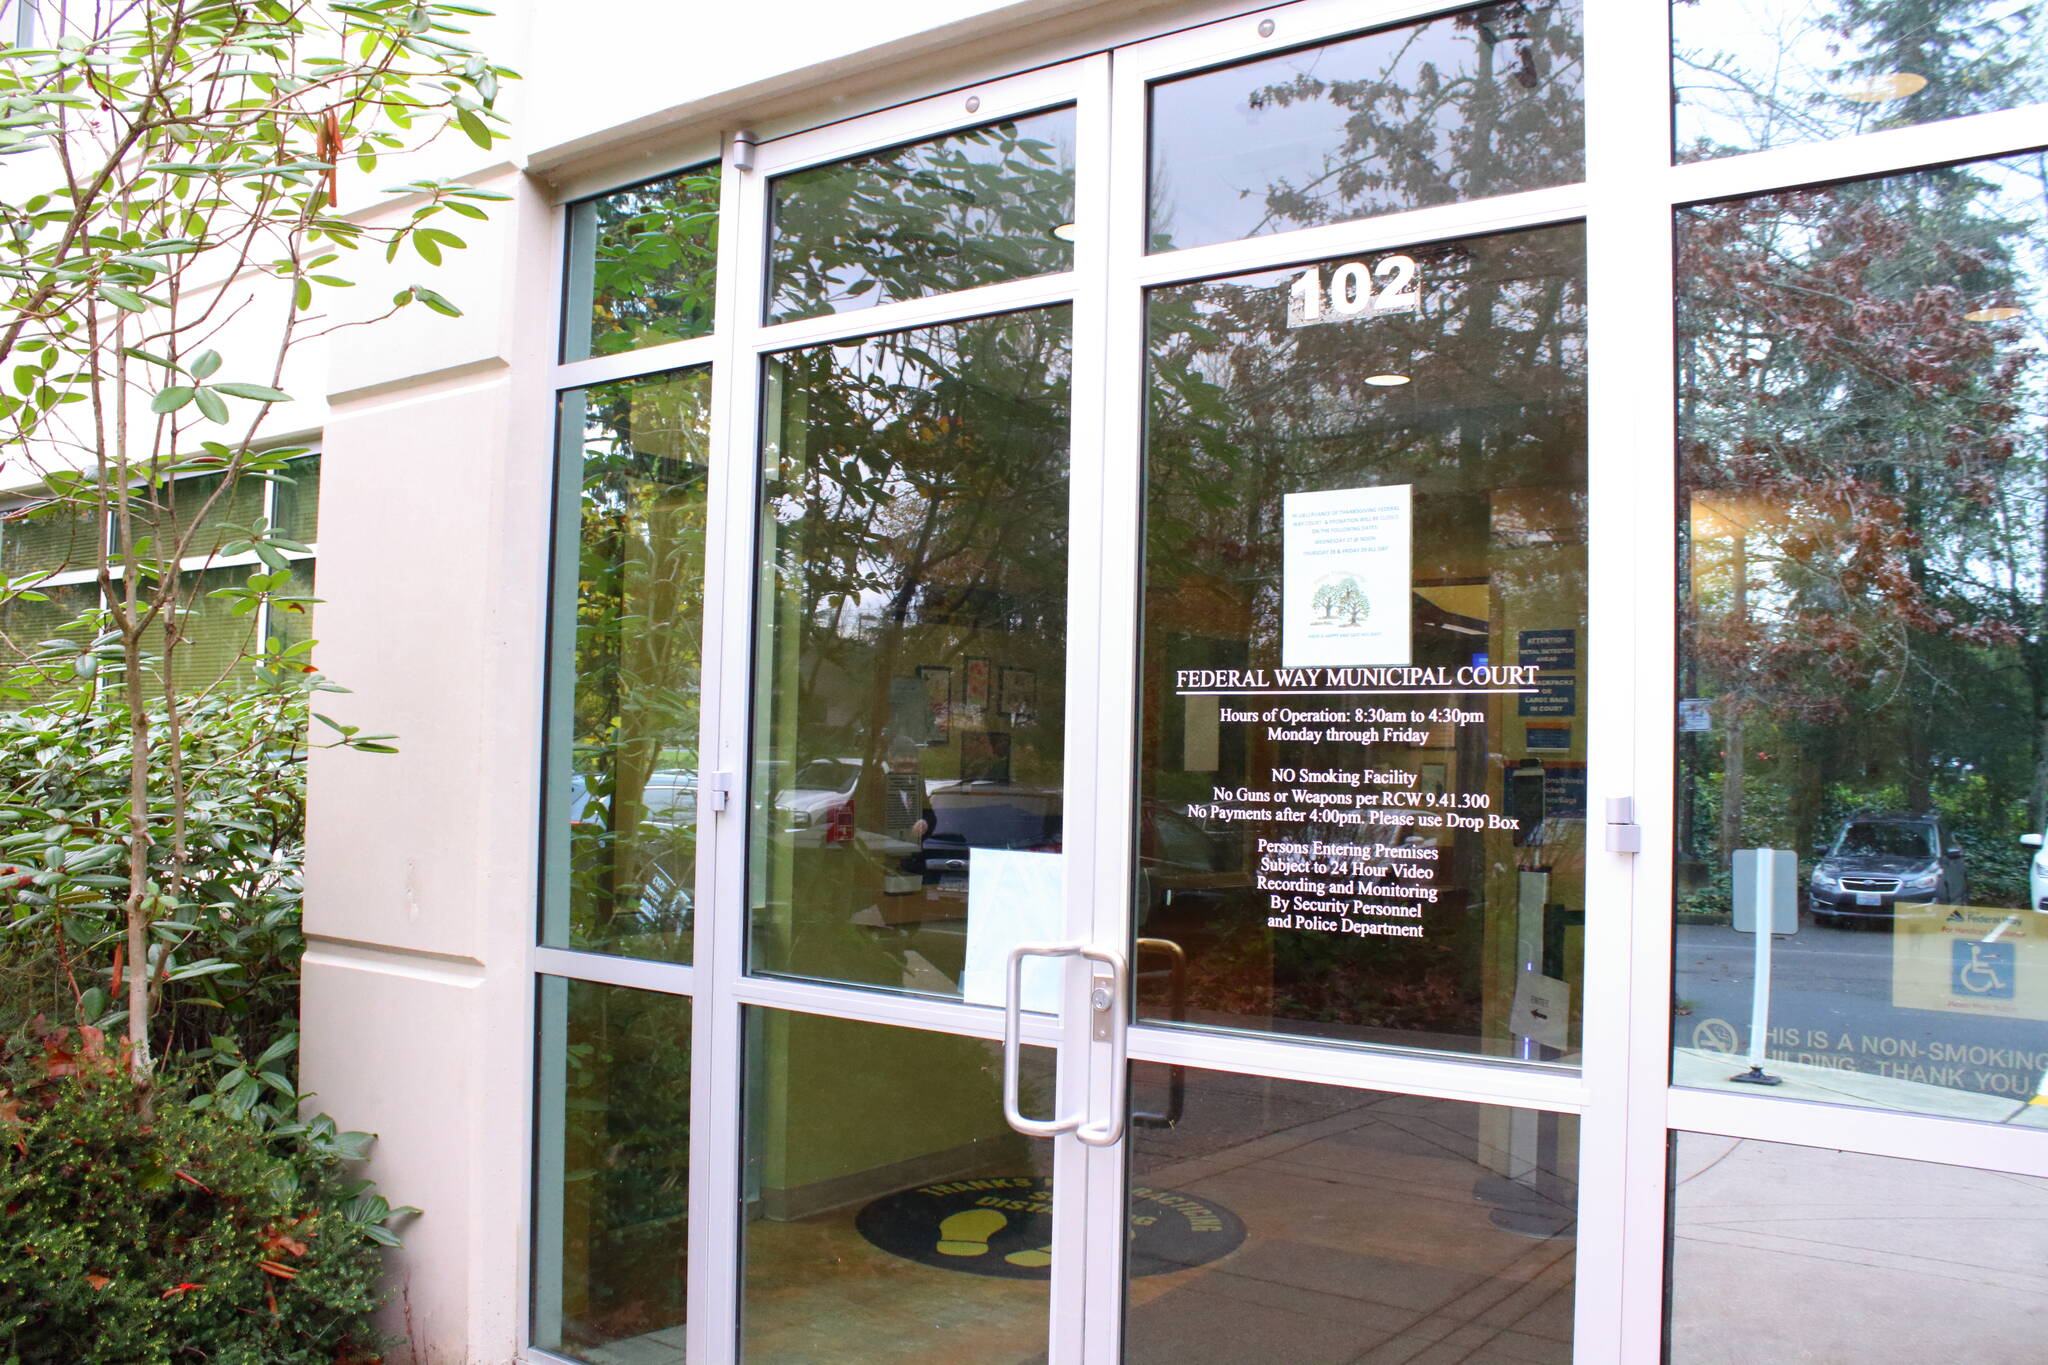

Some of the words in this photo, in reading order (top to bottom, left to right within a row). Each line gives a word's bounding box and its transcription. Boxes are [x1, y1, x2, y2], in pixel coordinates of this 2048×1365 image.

[1291, 255, 1416, 320] 102
[1176, 669, 1270, 687] FEDERAL
[1274, 668, 1322, 687] WAY
[1326, 667, 1452, 687] MUNICIPAL
[1457, 665, 1540, 685] COURT
[1220, 708, 1259, 722] Hours
[1262, 708, 1280, 722] of
[1280, 708, 1351, 726] Operation:
[1355, 708, 1407, 723] 8:30am
[1411, 709, 1426, 723] to
[1429, 708, 1485, 727] 4:30pm
[1268, 727, 1323, 745] Monday
[1326, 727, 1379, 746] through
[1383, 728, 1430, 746] Friday
[1272, 768, 1296, 782] NO
[1299, 768, 1361, 788] Smoking
[1363, 769, 1419, 789] Facility
[1213, 786, 1234, 801] No
[1236, 787, 1271, 802] Guns
[1273, 790, 1289, 803] or
[1291, 789, 1352, 807] Weapons
[1355, 792, 1380, 809] per
[1382, 791, 1423, 807] RCW
[1425, 792, 1490, 809] 9.41.300
[1187, 803, 1208, 819] No
[1210, 804, 1273, 823] Payments
[1275, 807, 1307, 822] after
[1309, 809, 1365, 827] 4:00pm.
[1369, 810, 1415, 826] Please
[1418, 814, 1444, 827] use
[1446, 812, 1484, 832] Drop
[1487, 814, 1520, 830] Box
[1257, 838, 1310, 855] Persons
[1312, 841, 1372, 861] Entering
[1374, 843, 1439, 861] Premises
[1260, 857, 1310, 876] Subject
[1313, 860, 1328, 875] to
[1330, 860, 1348, 875] 24
[1351, 862, 1389, 878] Hour
[1391, 863, 1435, 880] Video
[1257, 875, 1326, 897] Recording
[1328, 879, 1355, 896] and
[1357, 880, 1438, 904] Monitoring
[1270, 895, 1290, 913] By
[1293, 896, 1350, 917] Security
[1353, 899, 1423, 918] Personnel
[1267, 913, 1292, 929] and
[1295, 914, 1338, 932] Police
[1340, 918, 1424, 938] Department
[1760, 1026, 1801, 1047] HIS
[1807, 1030, 1829, 1050] IS
[1837, 1033, 1854, 1053] A
[1874, 1060, 1965, 1088] THANK
[916, 1176, 1033, 1196] THANKS
